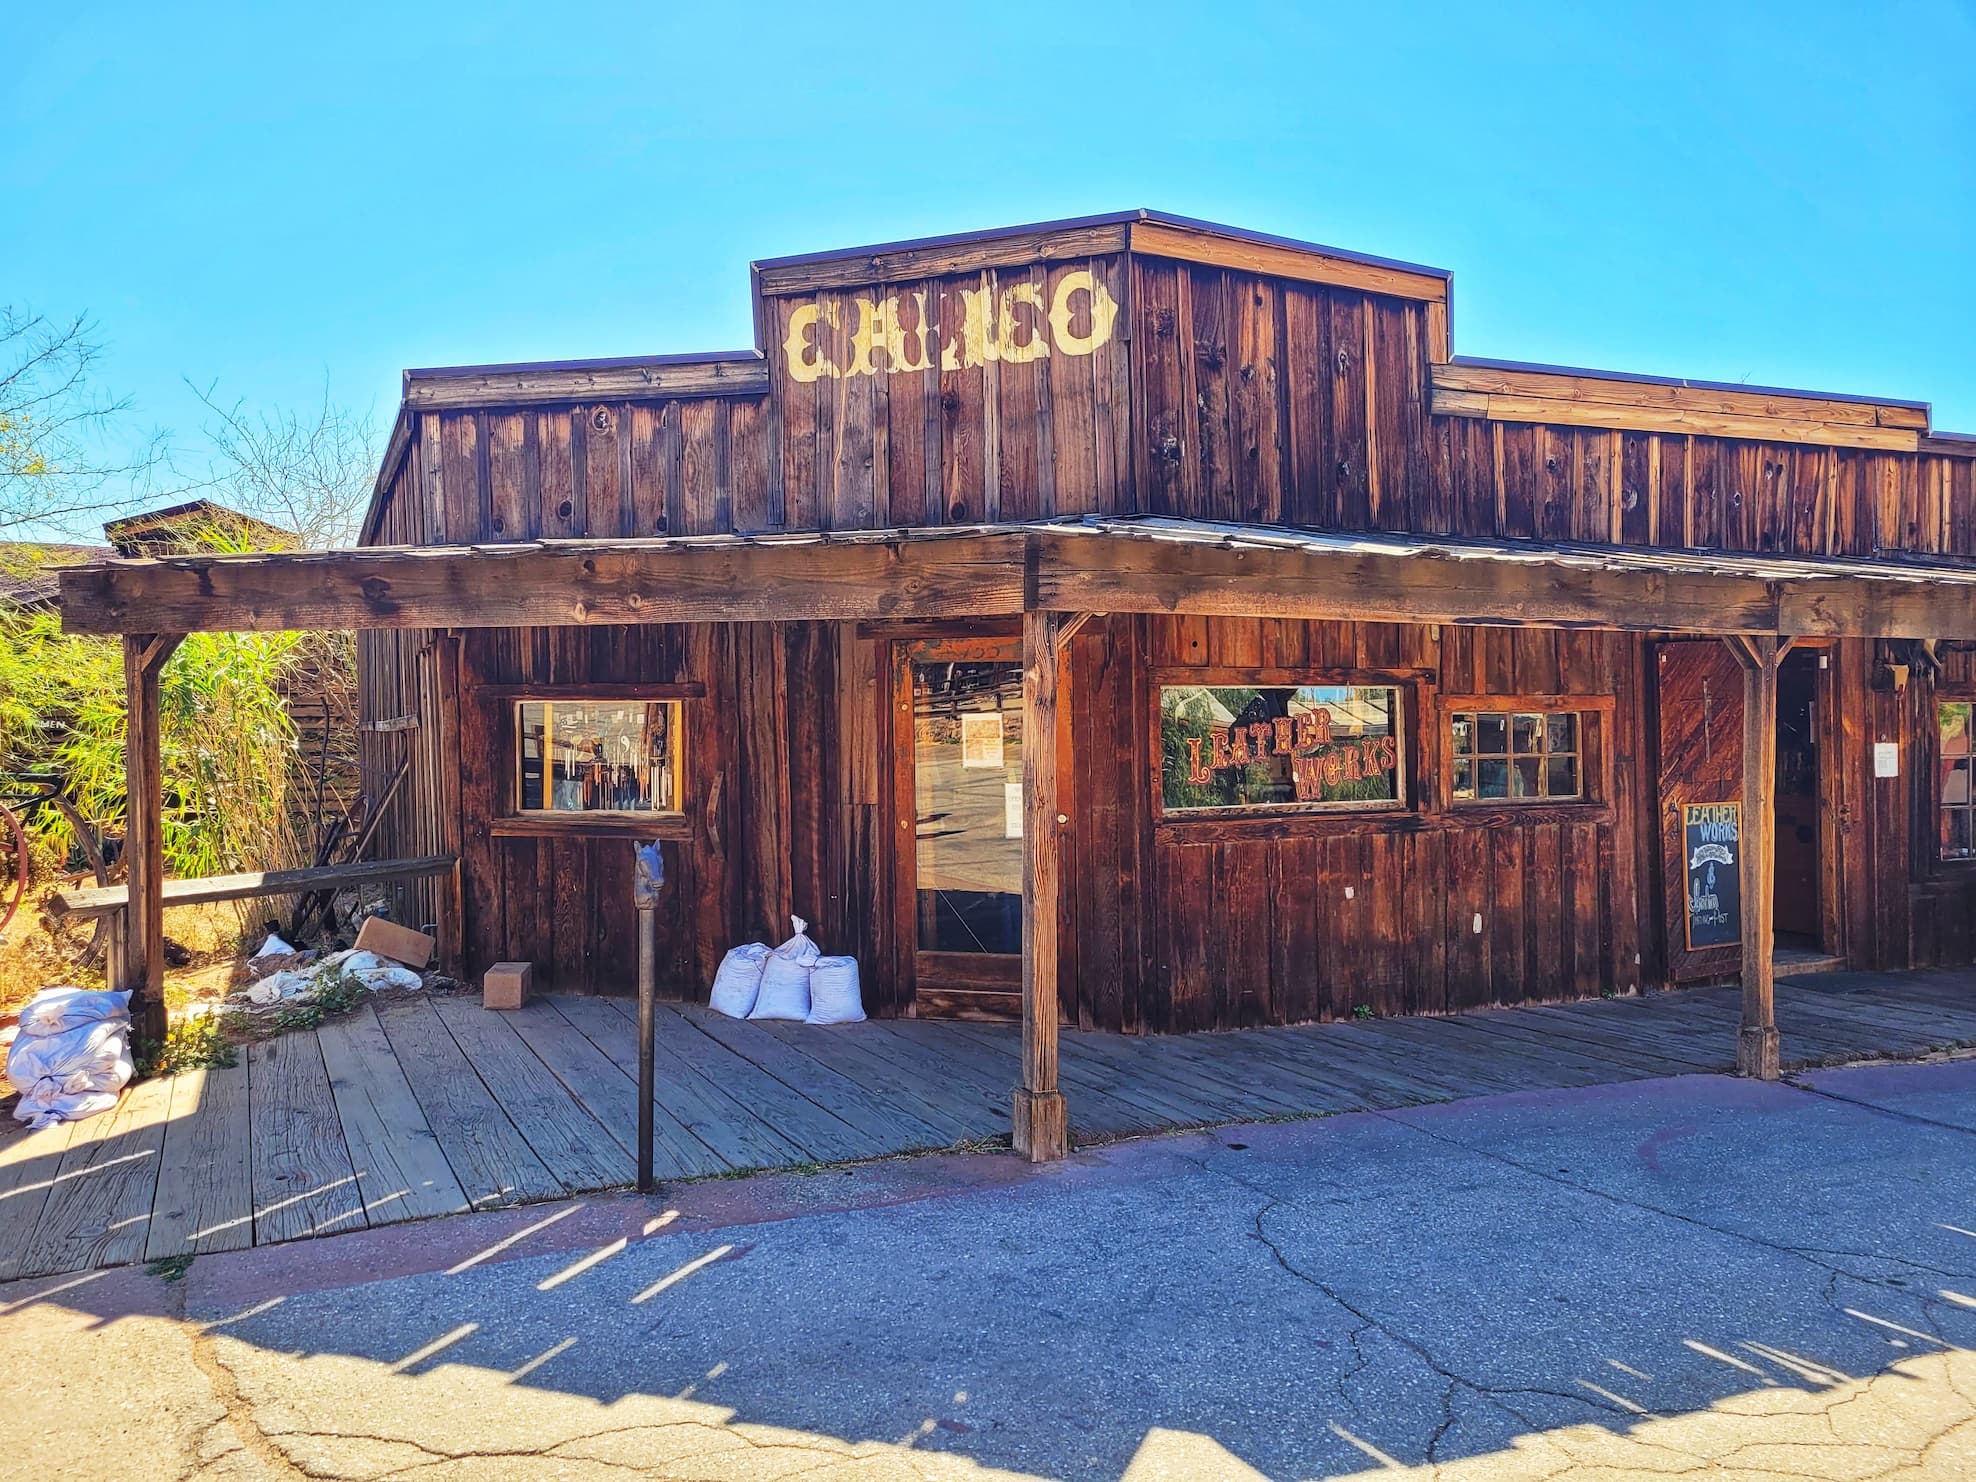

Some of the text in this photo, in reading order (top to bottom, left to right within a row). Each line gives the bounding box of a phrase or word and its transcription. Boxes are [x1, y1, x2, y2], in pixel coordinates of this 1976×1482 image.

[782, 271, 1119, 382] CALICO
[1187, 708, 1332, 784] LEATHER
[1294, 735, 1397, 800] WORKS
[1687, 805, 1737, 826] LEATHER
[1700, 822, 1738, 843] WORKS
